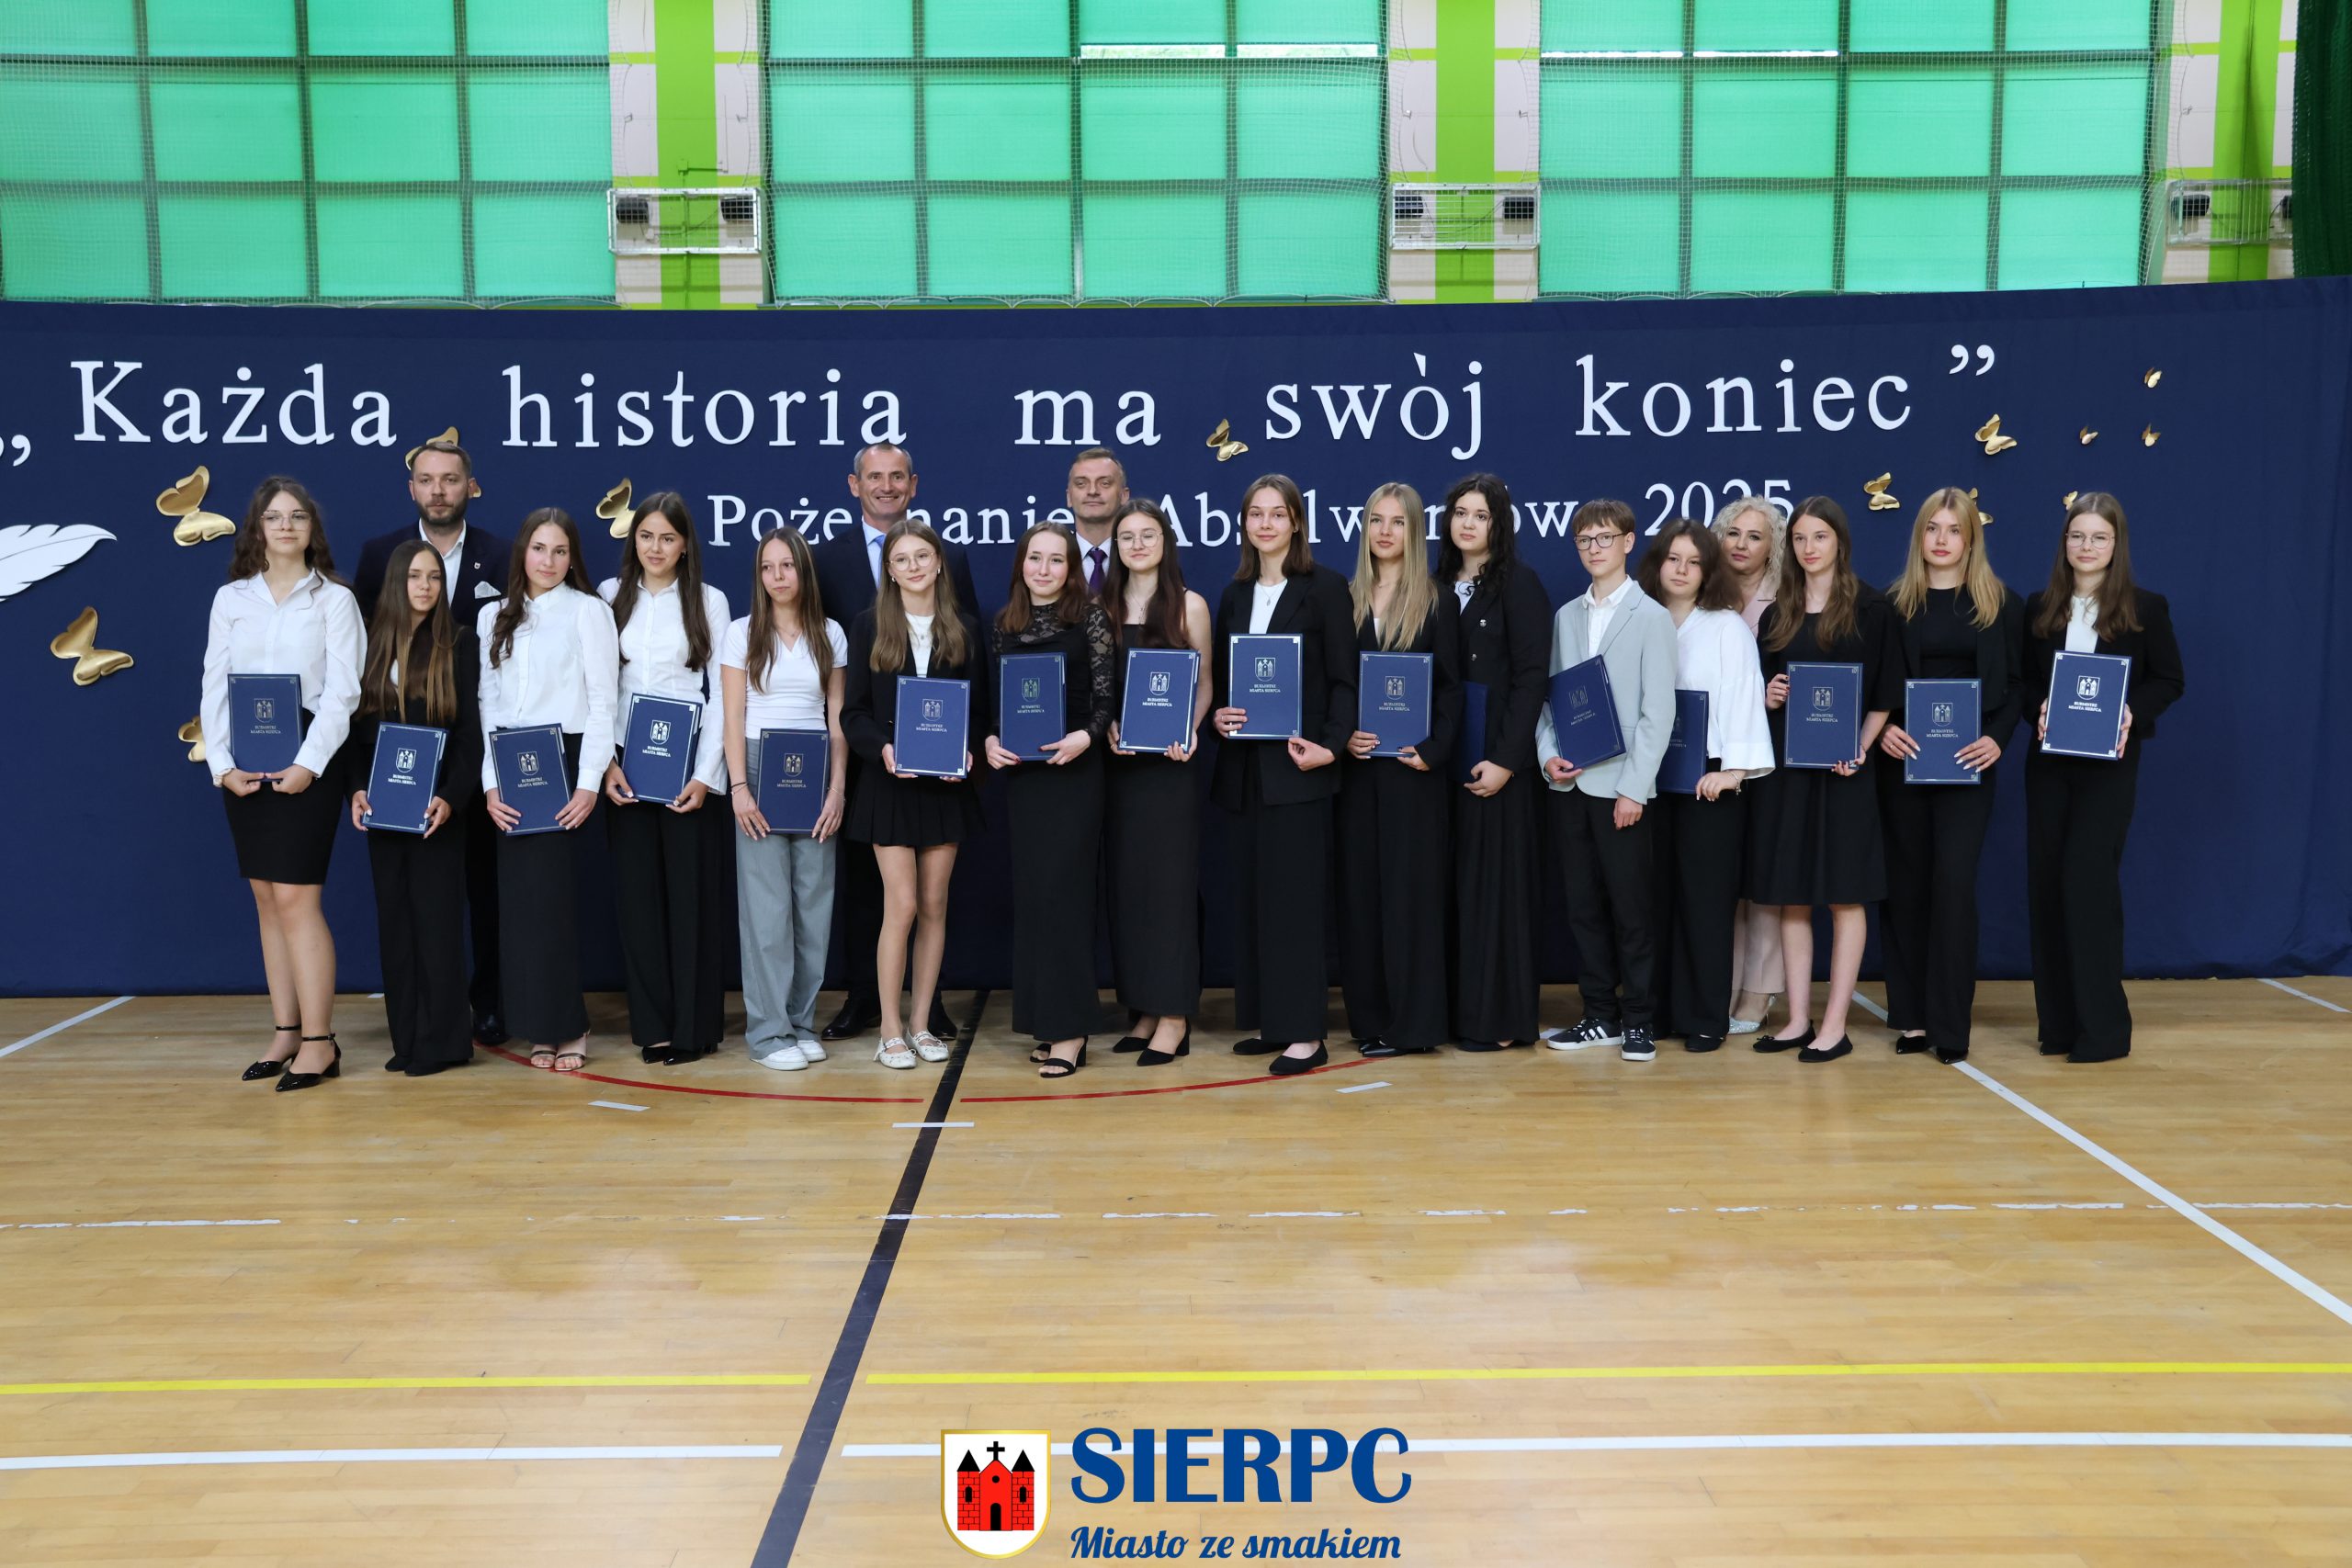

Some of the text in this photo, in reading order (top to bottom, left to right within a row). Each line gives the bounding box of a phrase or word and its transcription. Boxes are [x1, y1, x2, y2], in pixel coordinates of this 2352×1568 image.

[71, 361, 397, 445] Każda
[502, 364, 907, 447] historia
[1014, 389, 1161, 446] ma
[1575, 355, 1911, 437] koniec
